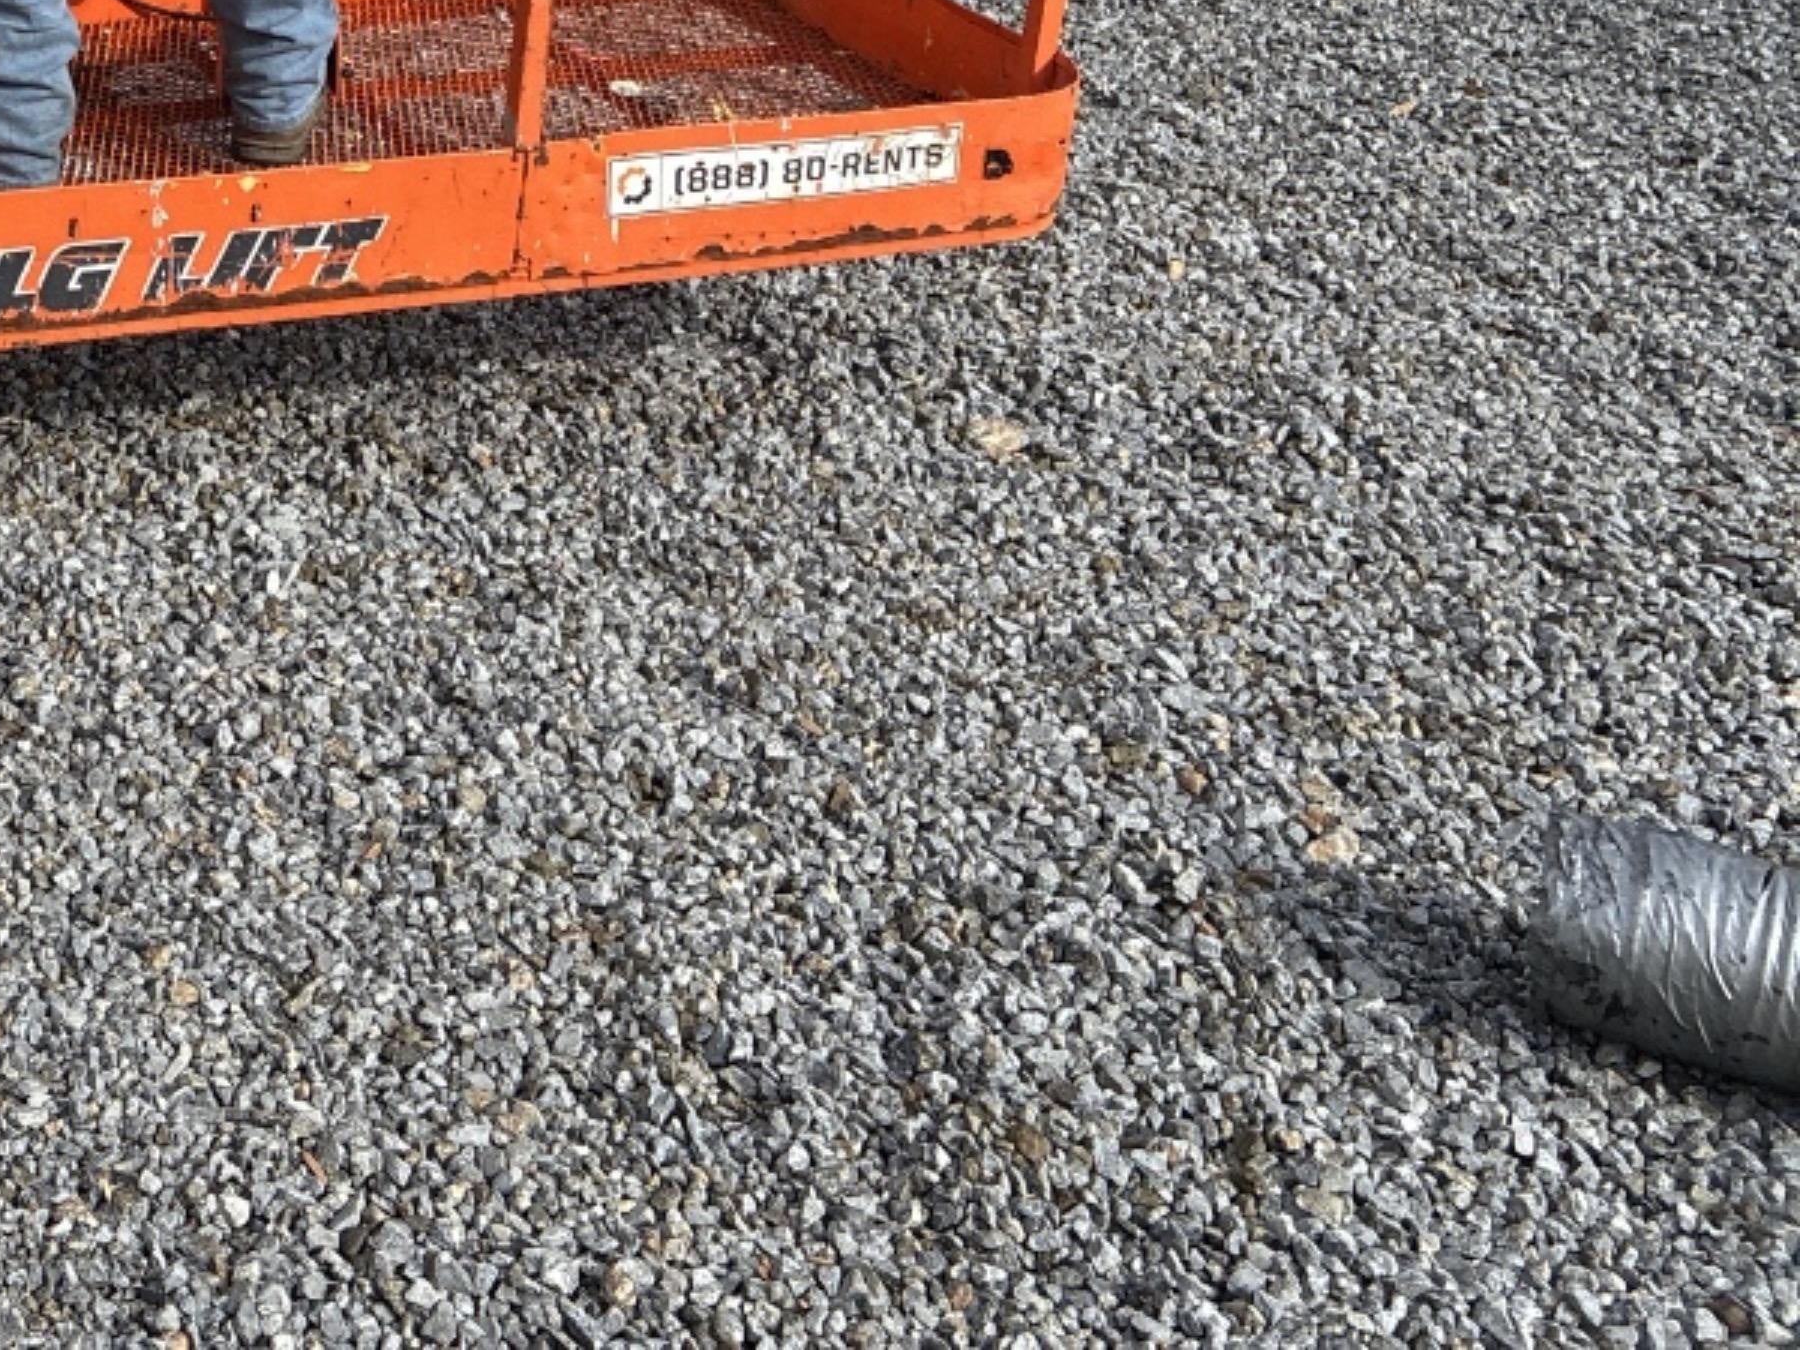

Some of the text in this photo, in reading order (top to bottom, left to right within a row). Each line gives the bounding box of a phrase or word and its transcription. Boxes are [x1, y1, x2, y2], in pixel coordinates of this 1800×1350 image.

[674, 144, 946, 197] (888) 80-RENTS
[141, 215, 390, 303] LIFT
